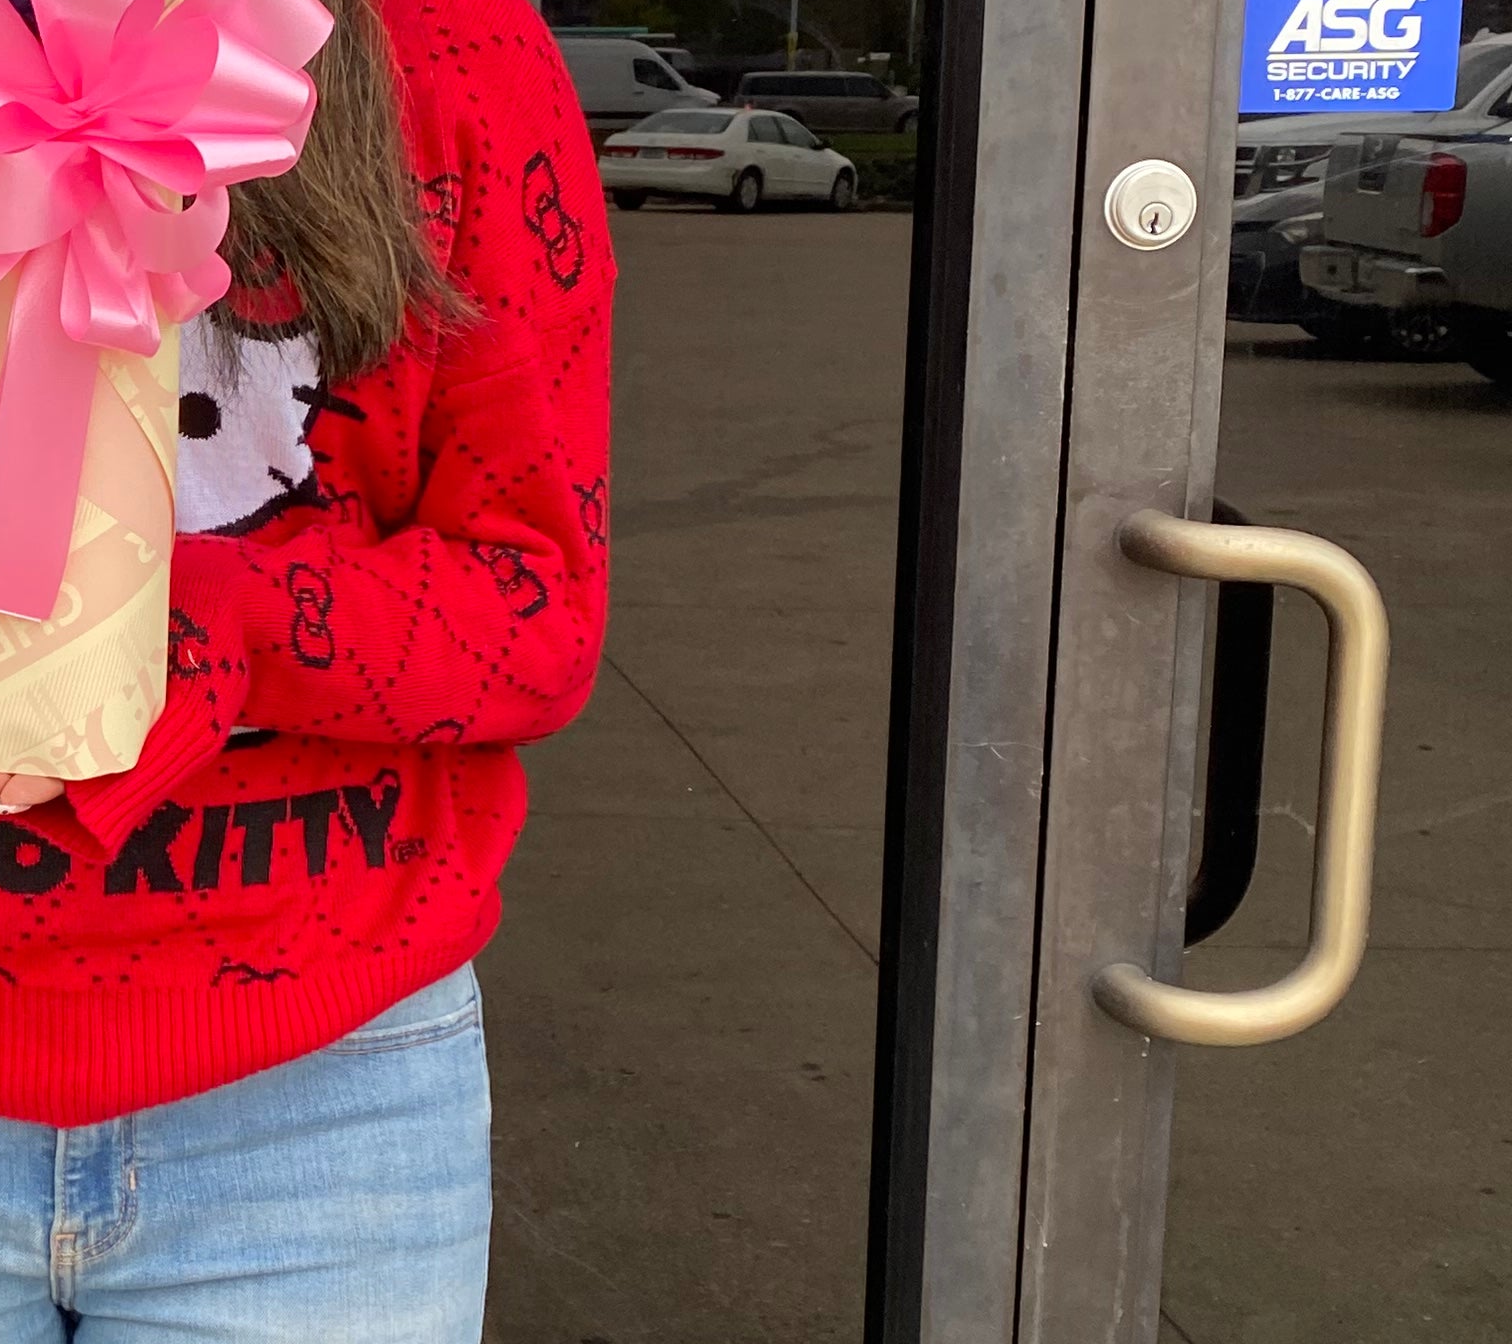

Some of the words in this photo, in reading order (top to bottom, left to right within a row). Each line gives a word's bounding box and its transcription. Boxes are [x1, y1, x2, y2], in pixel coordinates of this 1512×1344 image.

[1266, 59, 1417, 82] SECURITY
[1273, 87, 1401, 102] 1-877-CARE-ASG
[102, 783, 400, 896] KITTY
